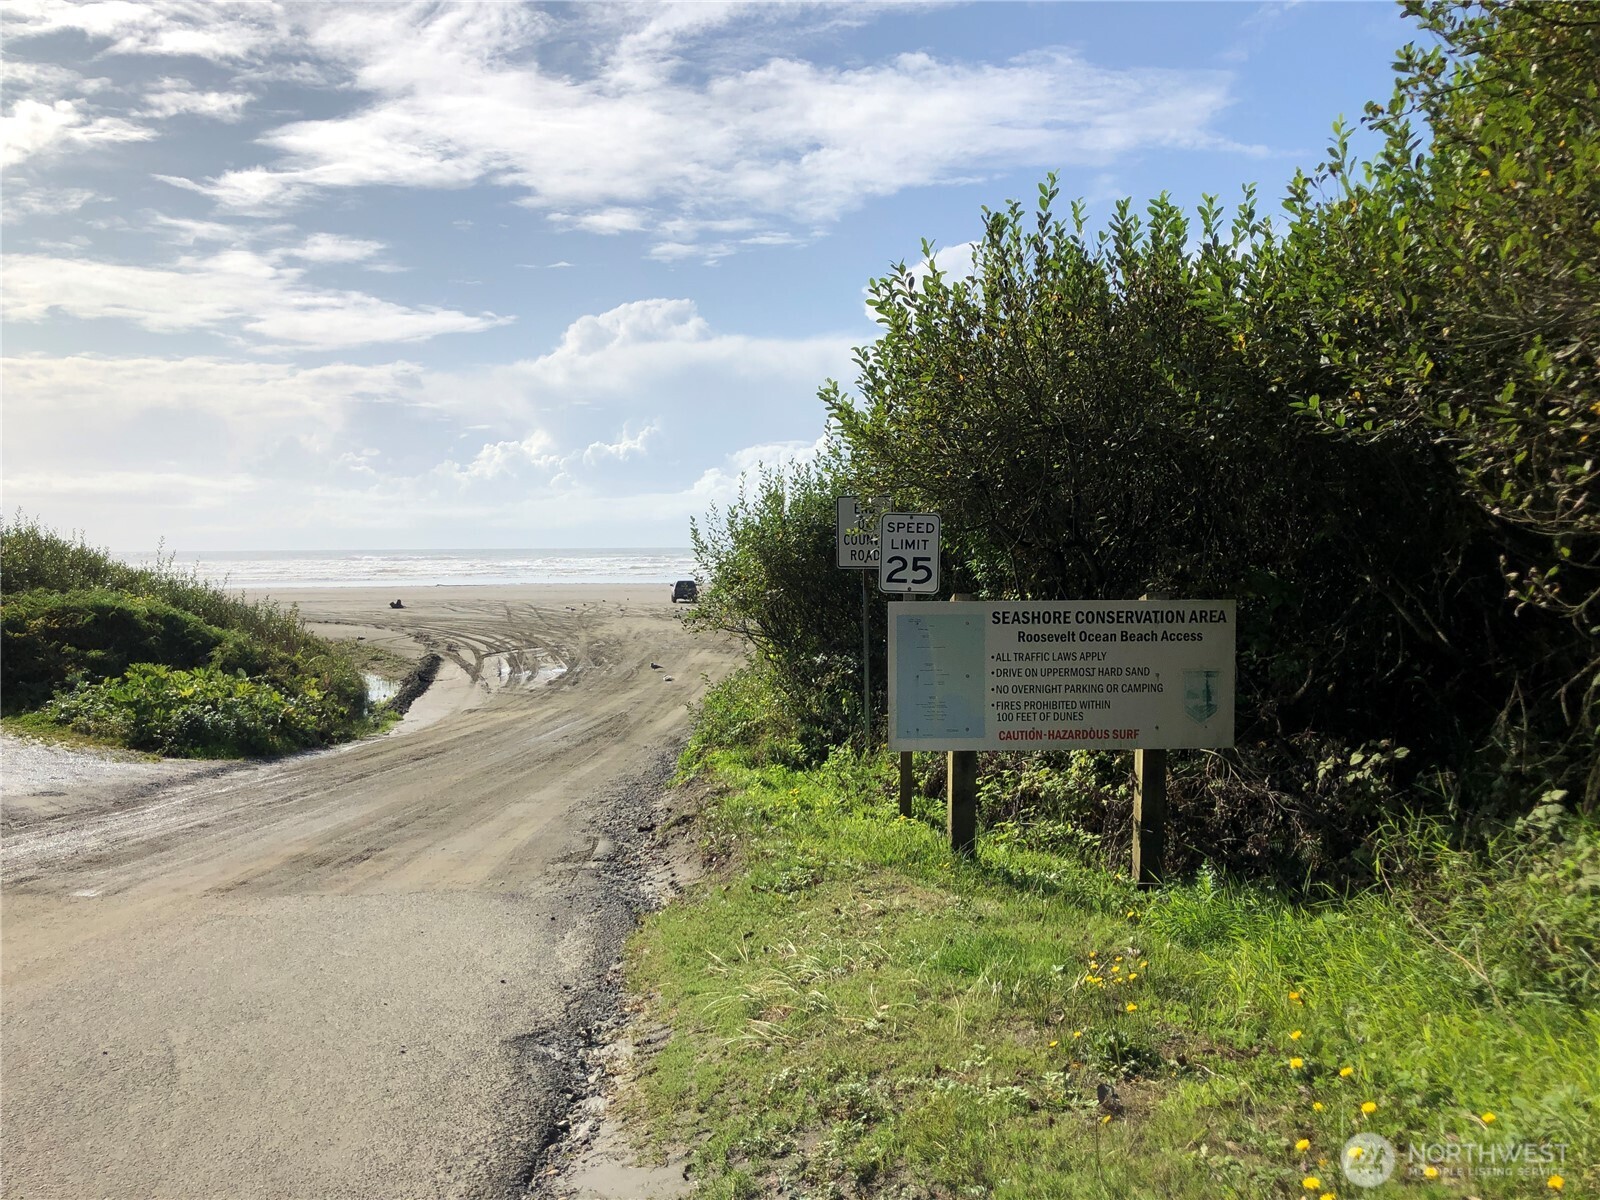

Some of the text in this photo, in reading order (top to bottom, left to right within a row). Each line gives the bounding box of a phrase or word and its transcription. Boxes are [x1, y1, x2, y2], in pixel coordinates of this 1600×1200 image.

[887, 522, 935, 534] SPEED
[844, 534, 879, 546] COUN
[891, 539, 929, 550] LIMIT
[850, 549, 880, 561] ROAD
[886, 555, 933, 584] 25
[992, 610, 1227, 624] SEASHORE CONSERVATION AREA
[1018, 630, 1203, 642] Roosevelt Ocean Beach Access
[995, 651, 1107, 662] ALL TRAFFIC LAWS APPLY
[996, 667, 1150, 677] DRIVE ON UPPERMOST HARD SAND
[996, 683, 1164, 694] NO OVERNIGHT PARKING OR CAMPING
[996, 700, 1111, 710] FIRES PROHIBITED WITHIN
[997, 712, 1084, 721] 100 FEET OF DUNES
[1112, 729, 1140, 739] SURF
